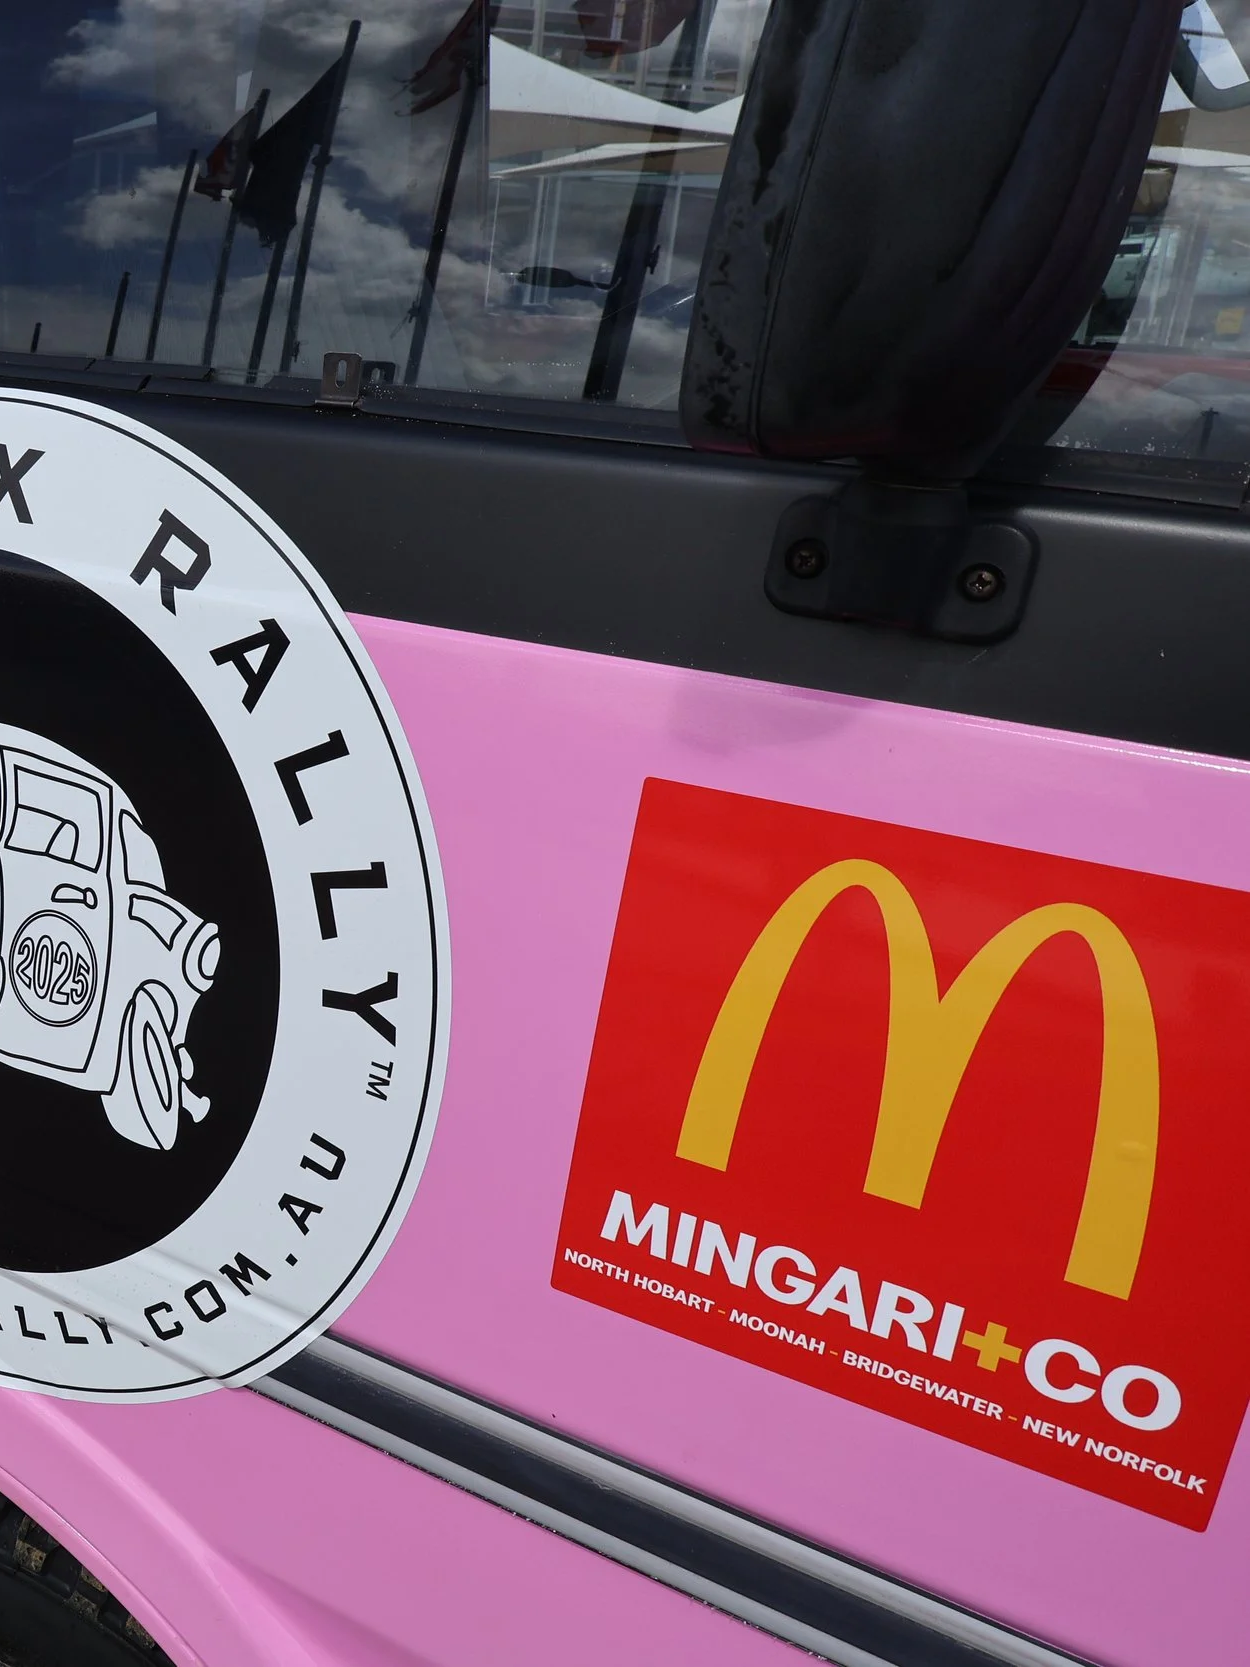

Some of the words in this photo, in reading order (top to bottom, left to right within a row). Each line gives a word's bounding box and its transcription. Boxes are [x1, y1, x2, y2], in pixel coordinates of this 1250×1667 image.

[130, 508, 399, 1048] RALLY
[16, 935, 90, 1006] 2025
[563, 1248, 630, 1284] NORTH
[633, 1266, 715, 1314] HOBART
[729, 1309, 826, 1355] MOONAH
[842, 1350, 1003, 1421] BRIDGEWATER
[1022, 1415, 1080, 1447] NEW
[1084, 1437, 1207, 1495] NORFOLK
[600, 1190, 1181, 1431] MINGARI+CO
